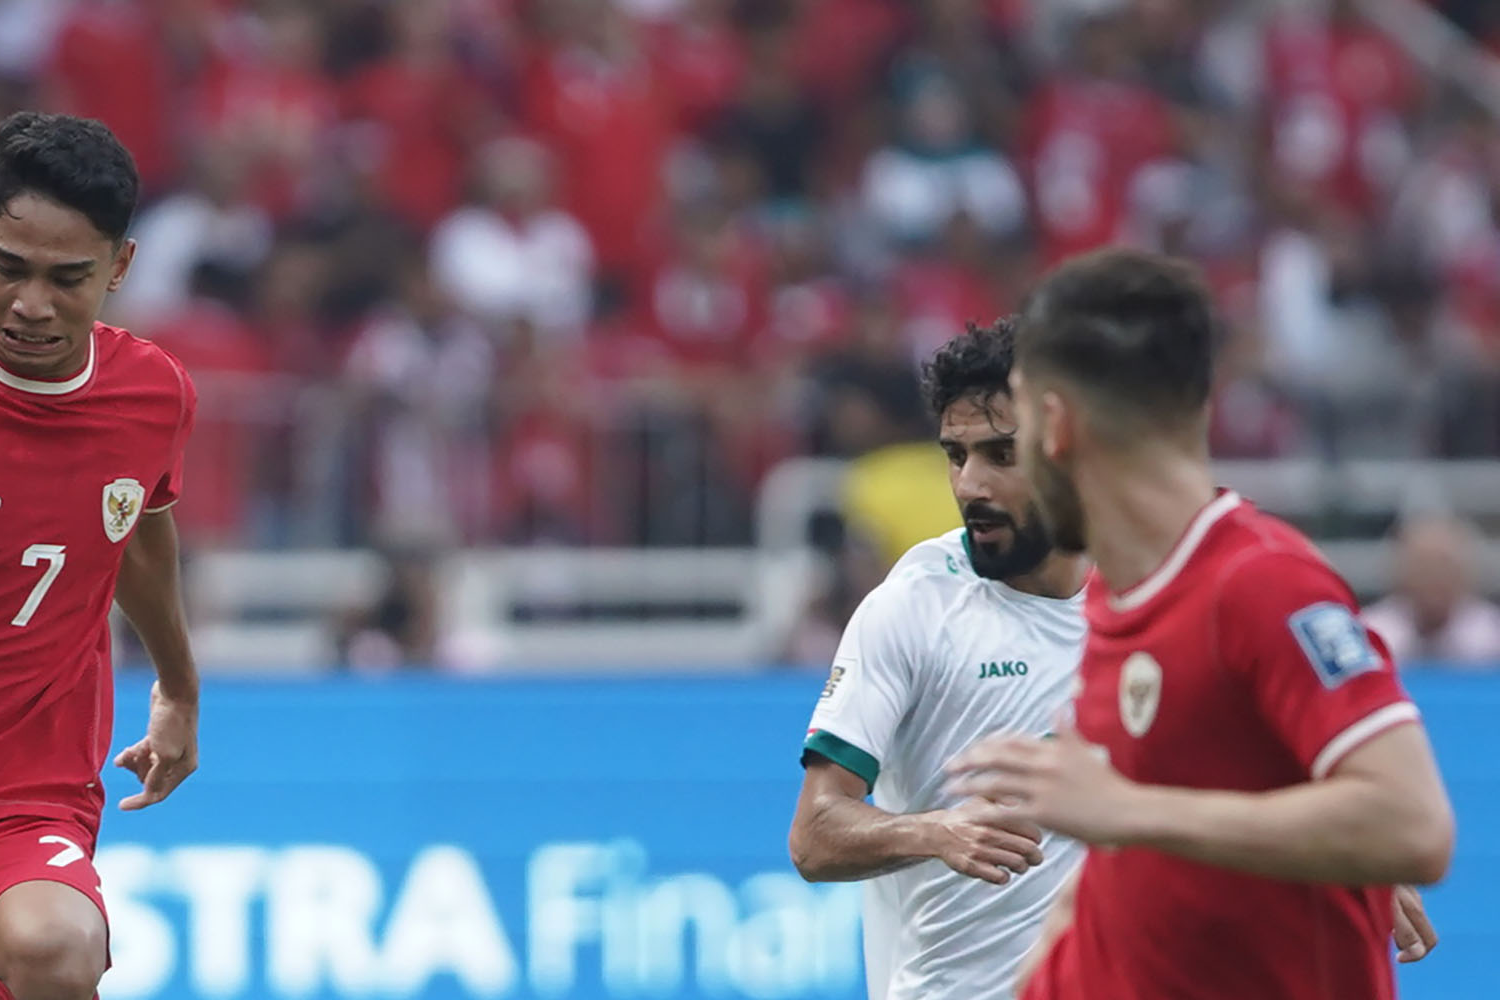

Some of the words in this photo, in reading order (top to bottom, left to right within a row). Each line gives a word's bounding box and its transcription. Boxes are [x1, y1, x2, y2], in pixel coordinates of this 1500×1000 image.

[11, 543, 67, 627] 7
[978, 660, 1028, 679] JAKO
[38, 835, 85, 868] 7
